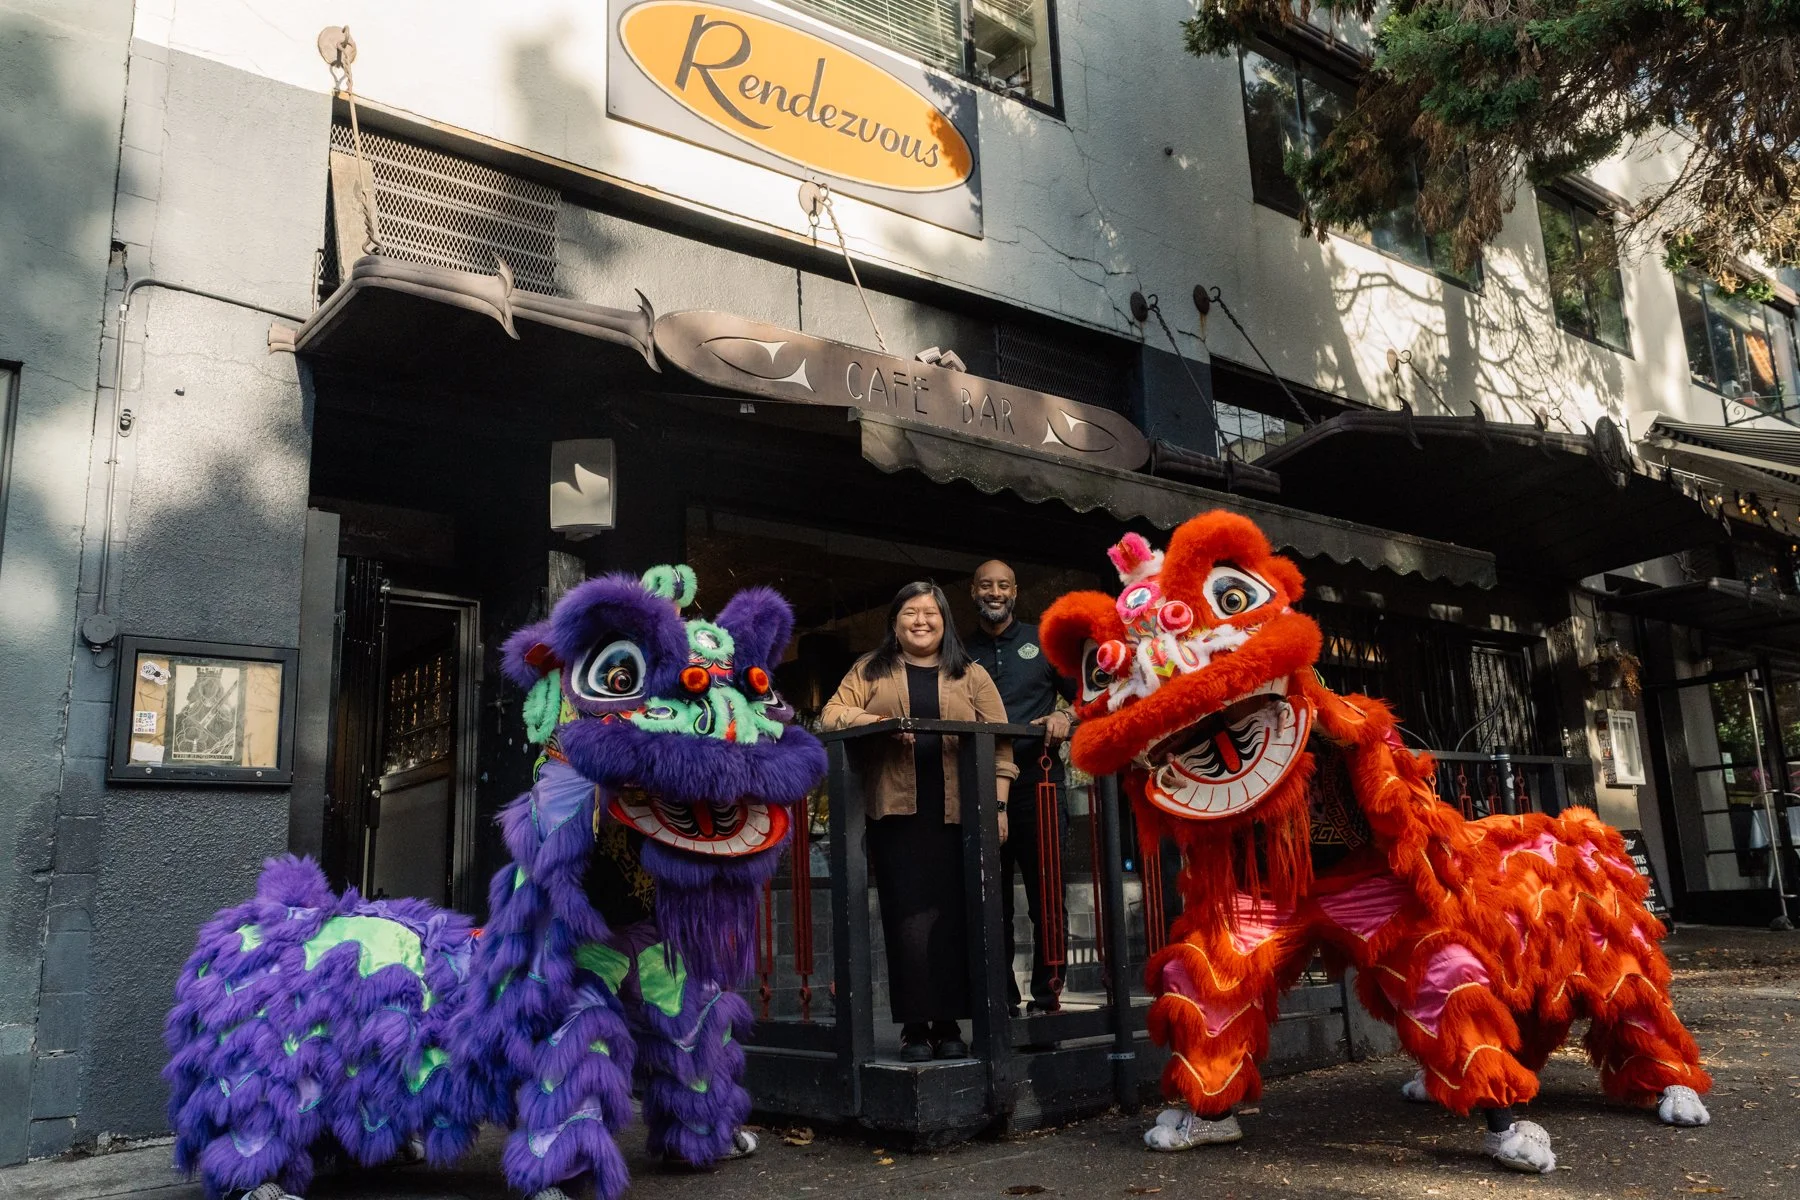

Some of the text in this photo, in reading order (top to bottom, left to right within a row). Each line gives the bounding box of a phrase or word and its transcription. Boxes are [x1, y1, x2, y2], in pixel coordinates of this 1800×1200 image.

[675, 14, 939, 168] Rendezvous
[846, 361, 1015, 436] CAFE BAR
